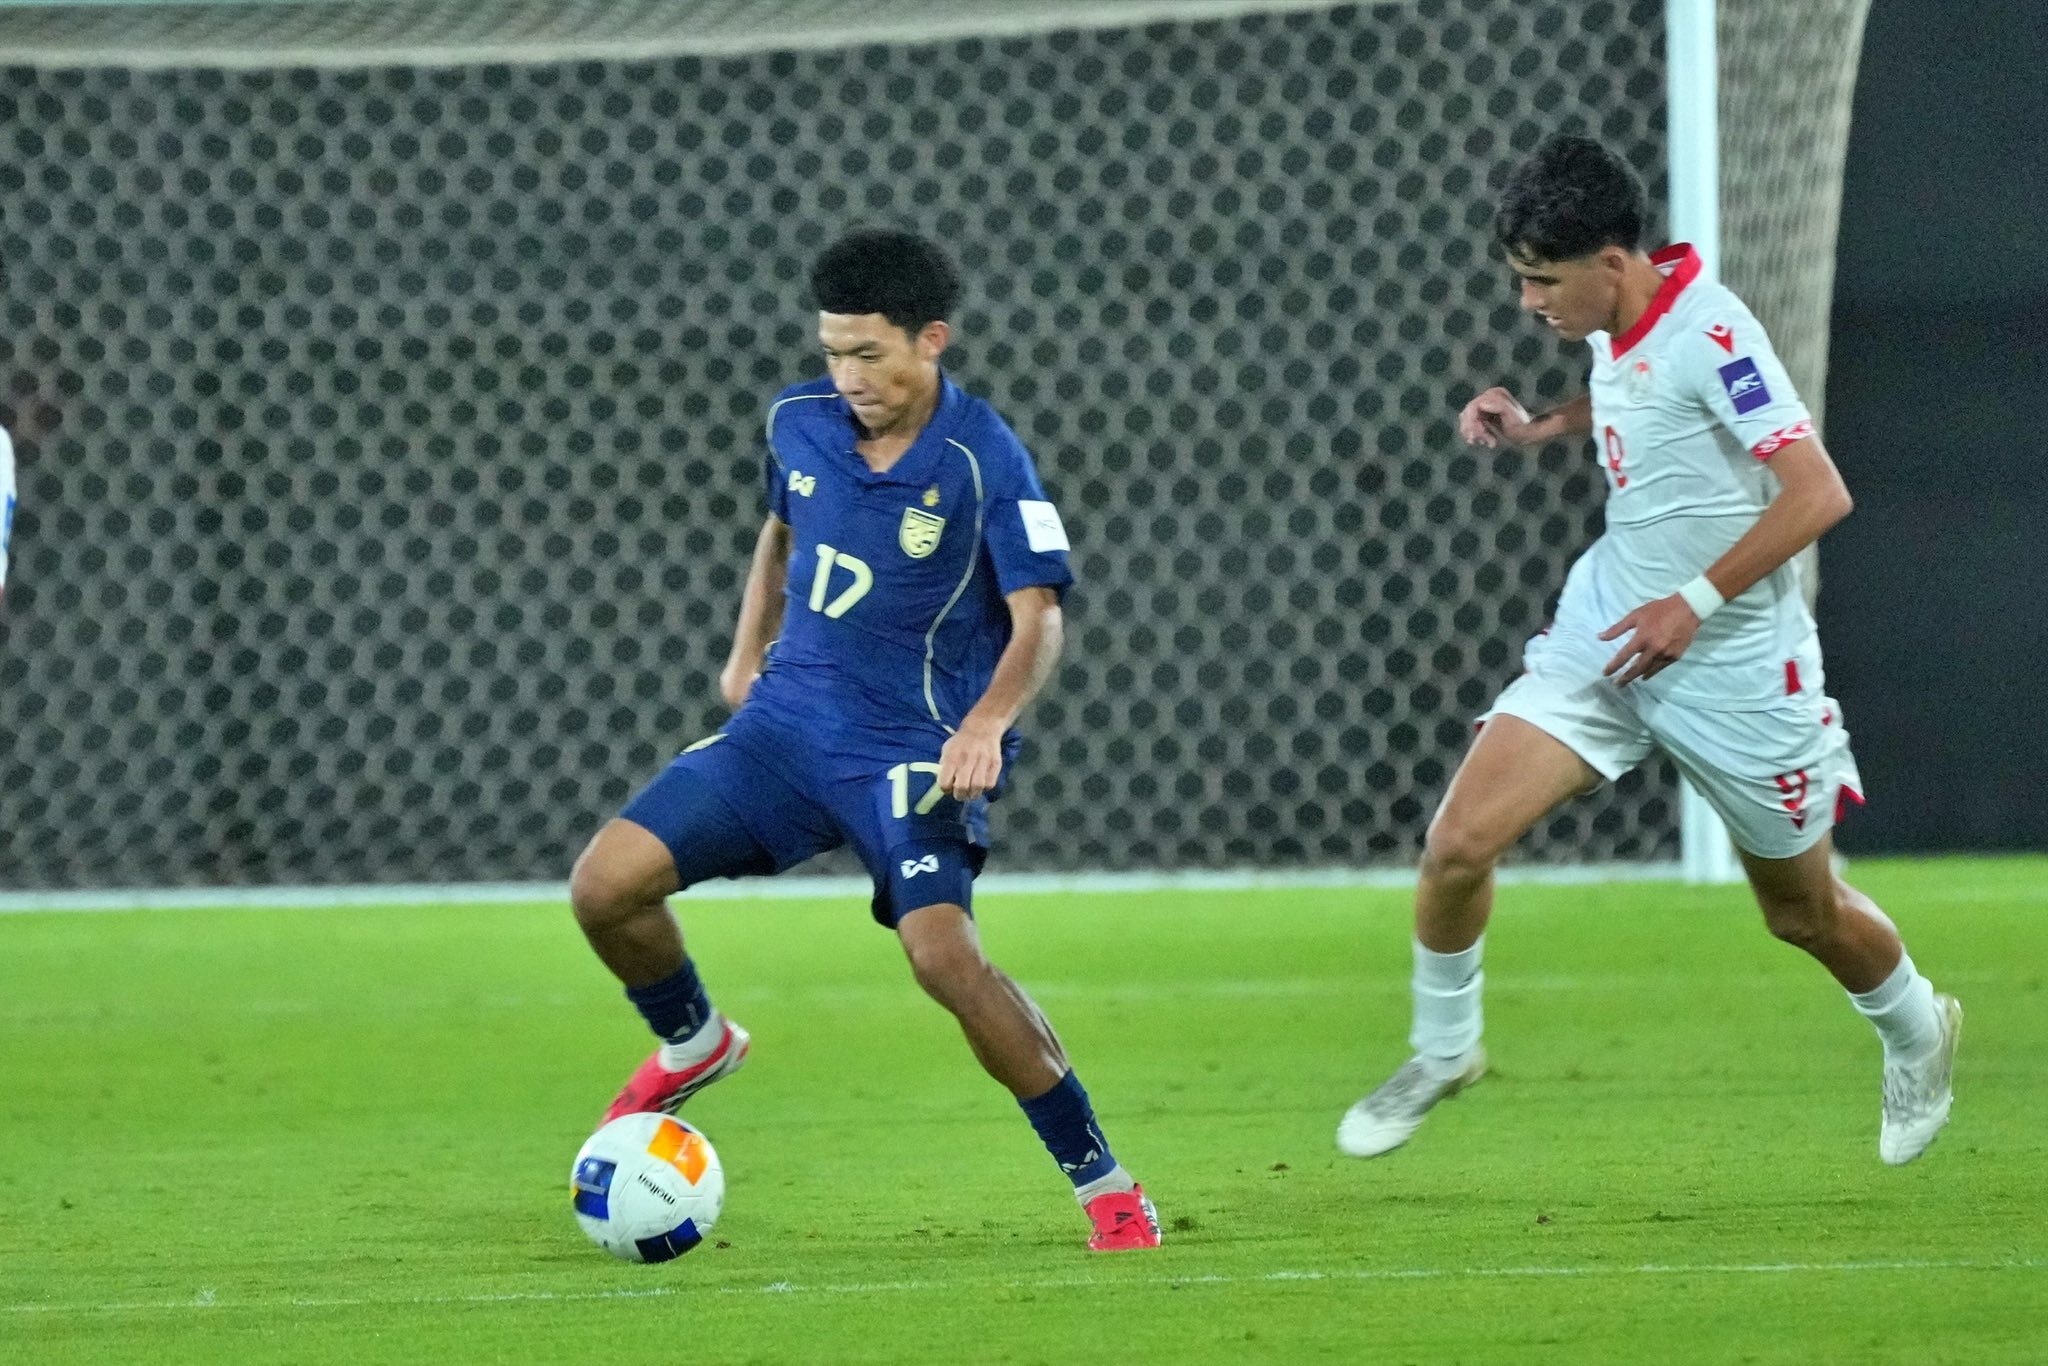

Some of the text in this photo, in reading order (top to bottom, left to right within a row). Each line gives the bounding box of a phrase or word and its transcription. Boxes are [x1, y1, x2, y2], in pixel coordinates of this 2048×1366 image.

[809, 543, 873, 619] 17
[887, 761, 943, 819] 17
[1774, 769, 1809, 811] 9
